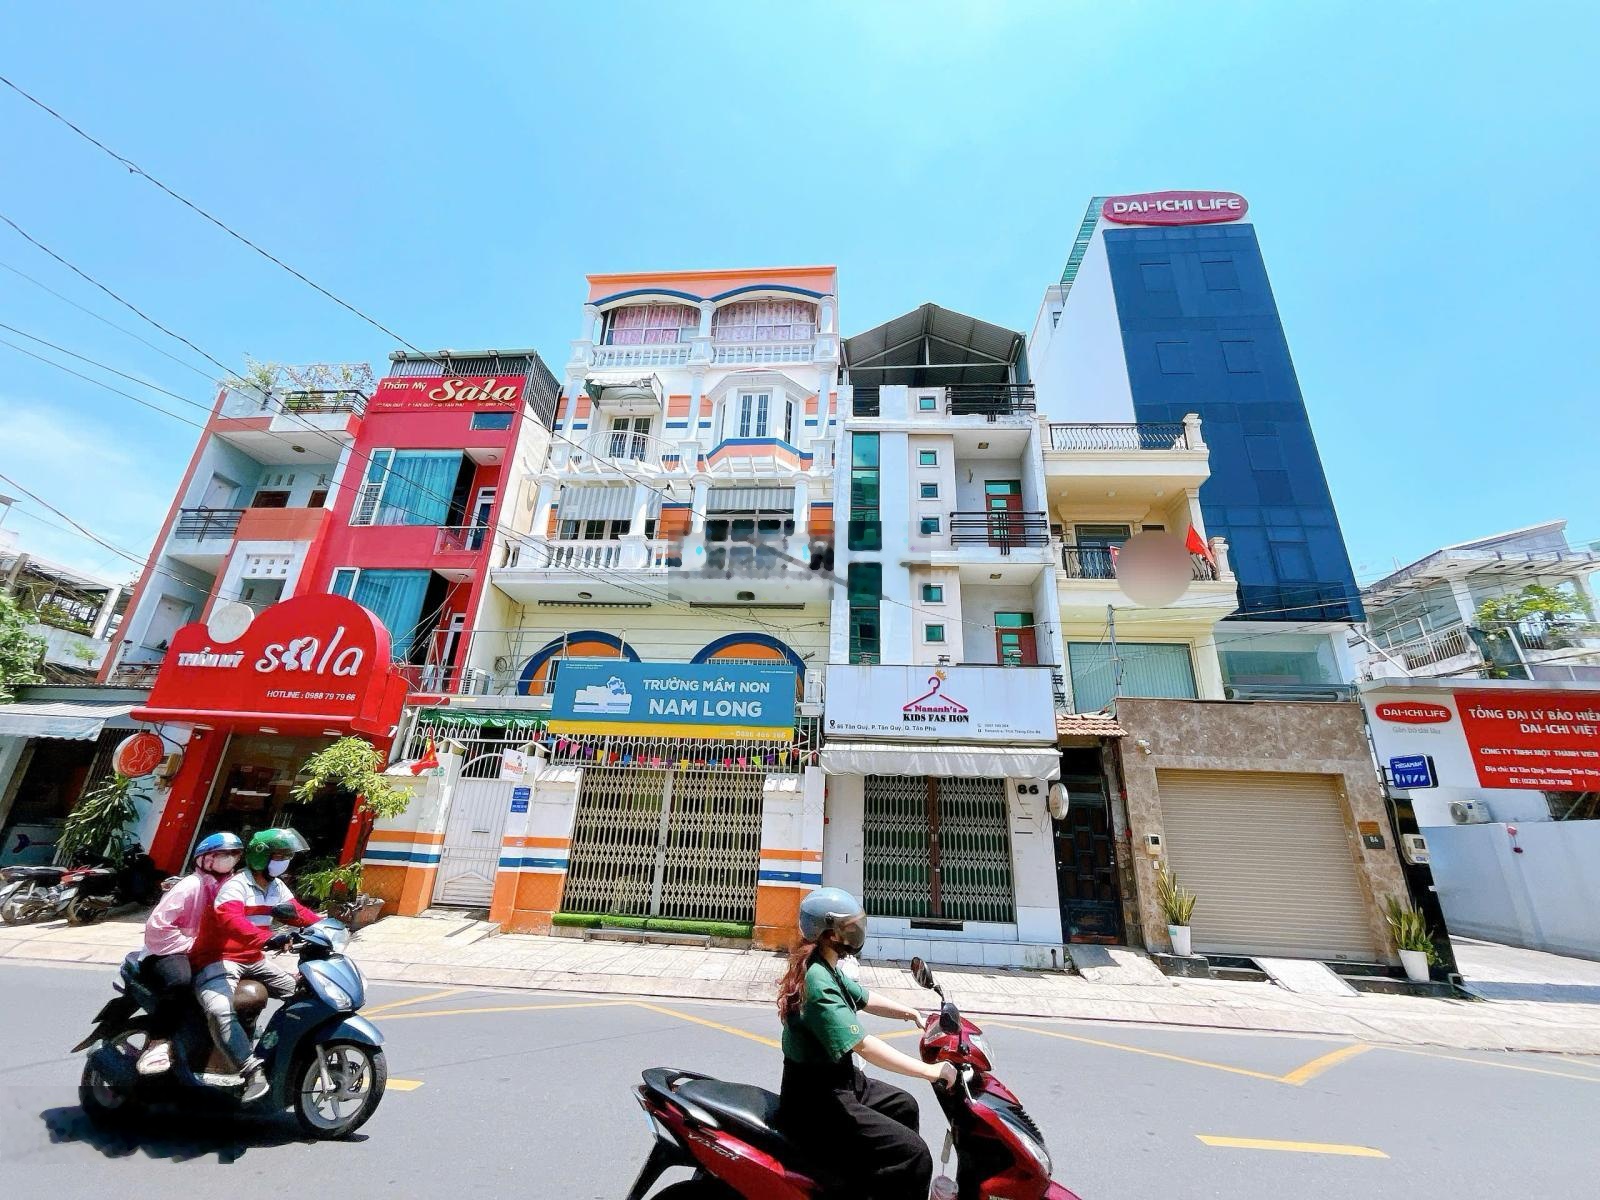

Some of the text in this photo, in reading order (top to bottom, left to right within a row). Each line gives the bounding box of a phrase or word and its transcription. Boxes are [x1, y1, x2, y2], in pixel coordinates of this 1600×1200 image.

[1113, 198, 1241, 213] DAI-ICHI LIFE
[428, 378, 517, 401] Sala
[643, 677, 770, 693] TRƯỜNG MẦM NON
[266, 690, 301, 699] HOTLINE
[305, 692, 324, 700] 0988
[336, 693, 346, 701] 79
[649, 698, 763, 718] NAM LONG
[1383, 708, 1447, 718] DAI-ICHI LIFE
[1468, 704, 1504, 719] TỔNG
[1506, 710, 1529, 721] ĐẠI
[1530, 708, 1544, 720] LÝ
[1547, 708, 1574, 721] BẢO
[903, 713, 926, 722] KIDS
[1520, 723, 1598, 737] DAI-ICHI VIỆT
